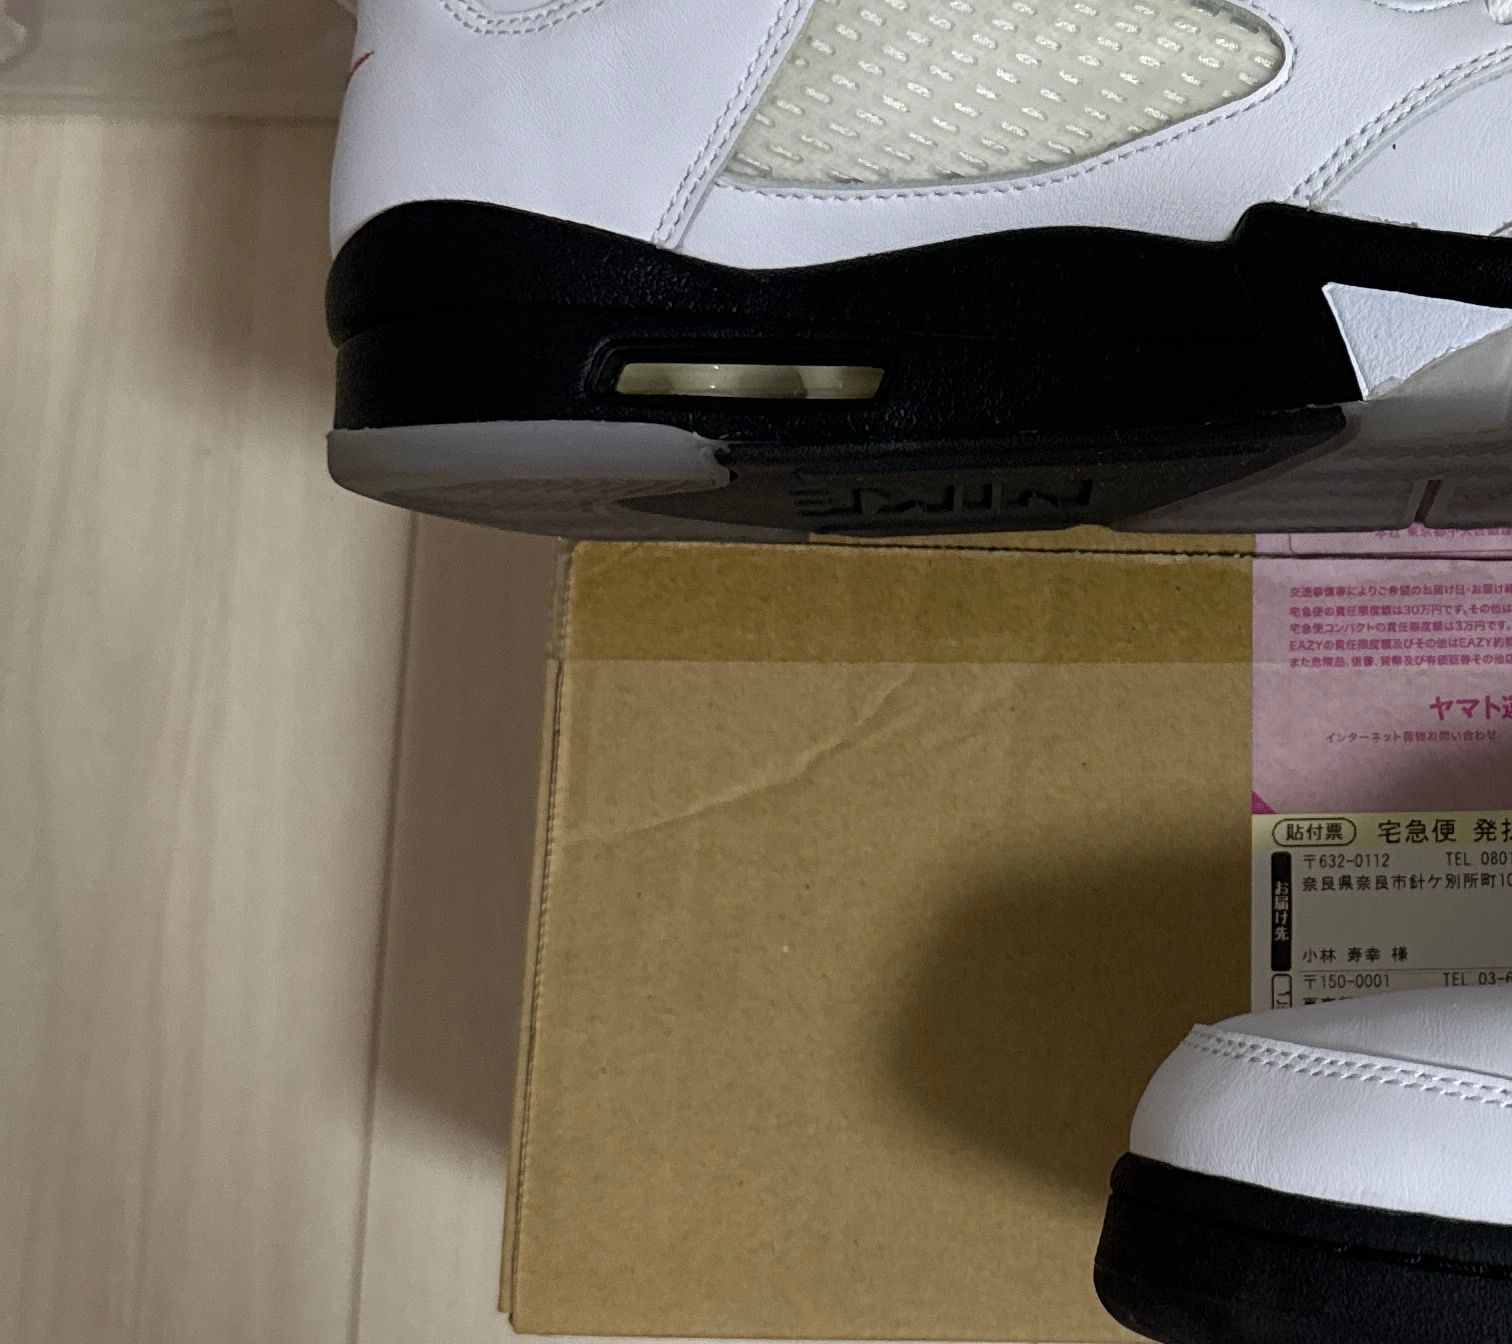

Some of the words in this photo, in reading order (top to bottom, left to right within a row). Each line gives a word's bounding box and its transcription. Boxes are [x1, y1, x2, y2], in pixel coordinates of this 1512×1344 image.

[1285, 823, 1344, 842] 貼付票
[1378, 818, 1457, 843] 宅急便
[1446, 852, 1472, 867] TEL
[1274, 881, 1290, 942] お届け先
[1302, 946, 1337, 963] 小林
[1391, 946, 1408, 963] 様
[1443, 972, 1468, 987] TEL
